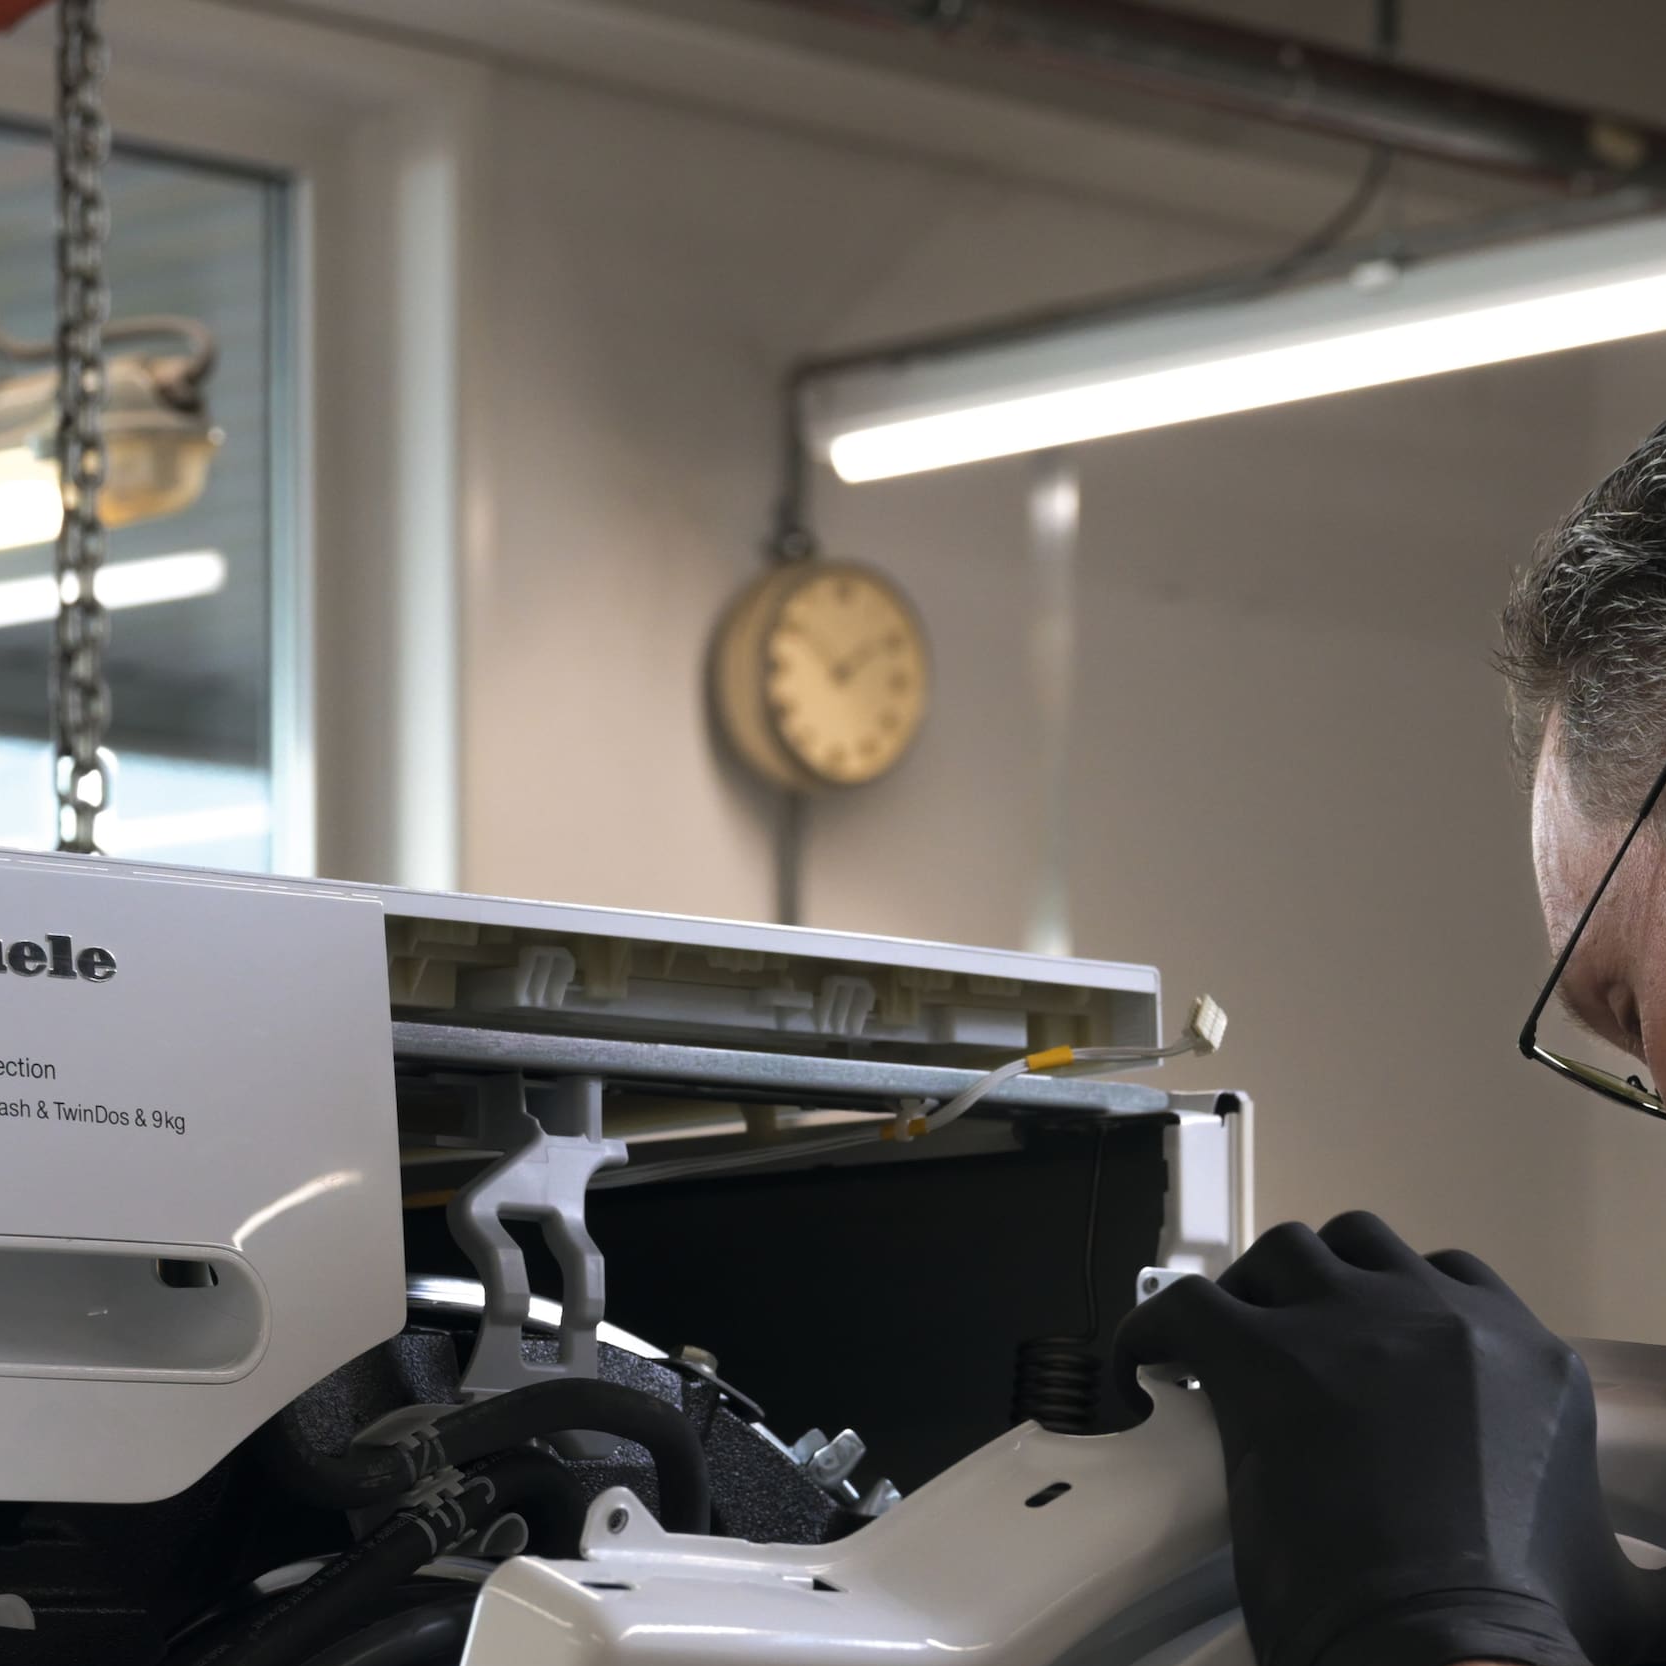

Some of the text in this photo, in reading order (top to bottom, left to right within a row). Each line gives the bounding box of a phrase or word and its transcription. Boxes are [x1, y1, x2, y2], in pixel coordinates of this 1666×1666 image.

[36, 1100, 50, 1120] &
[53, 1101, 130, 1127] TwinDos
[134, 1108, 148, 1128] &
[151, 1110, 186, 1135] 9kg
